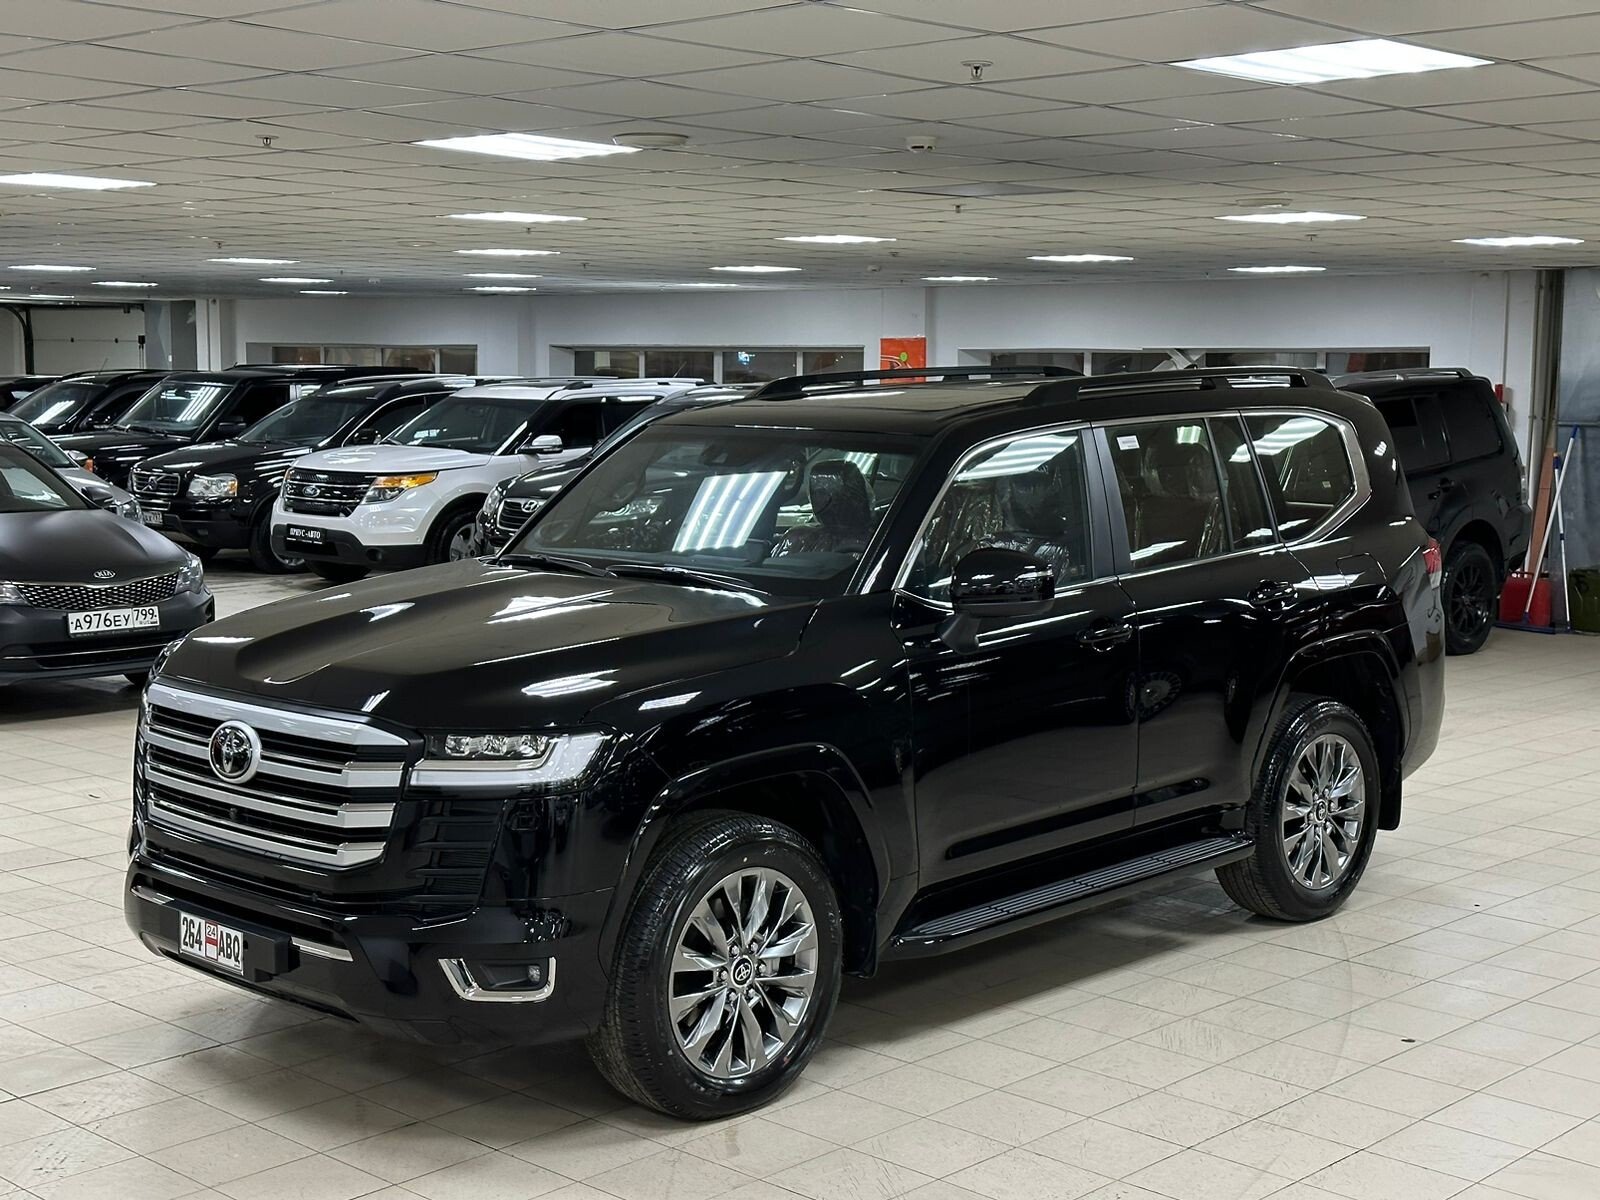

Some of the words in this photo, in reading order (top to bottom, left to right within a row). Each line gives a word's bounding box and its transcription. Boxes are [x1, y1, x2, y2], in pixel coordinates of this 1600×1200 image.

[74, 612, 131, 631] А976ЕУ
[133, 608, 155, 621] 799
[182, 916, 203, 952] 264
[206, 925, 216, 937] 24
[218, 930, 241, 965] ABQ
